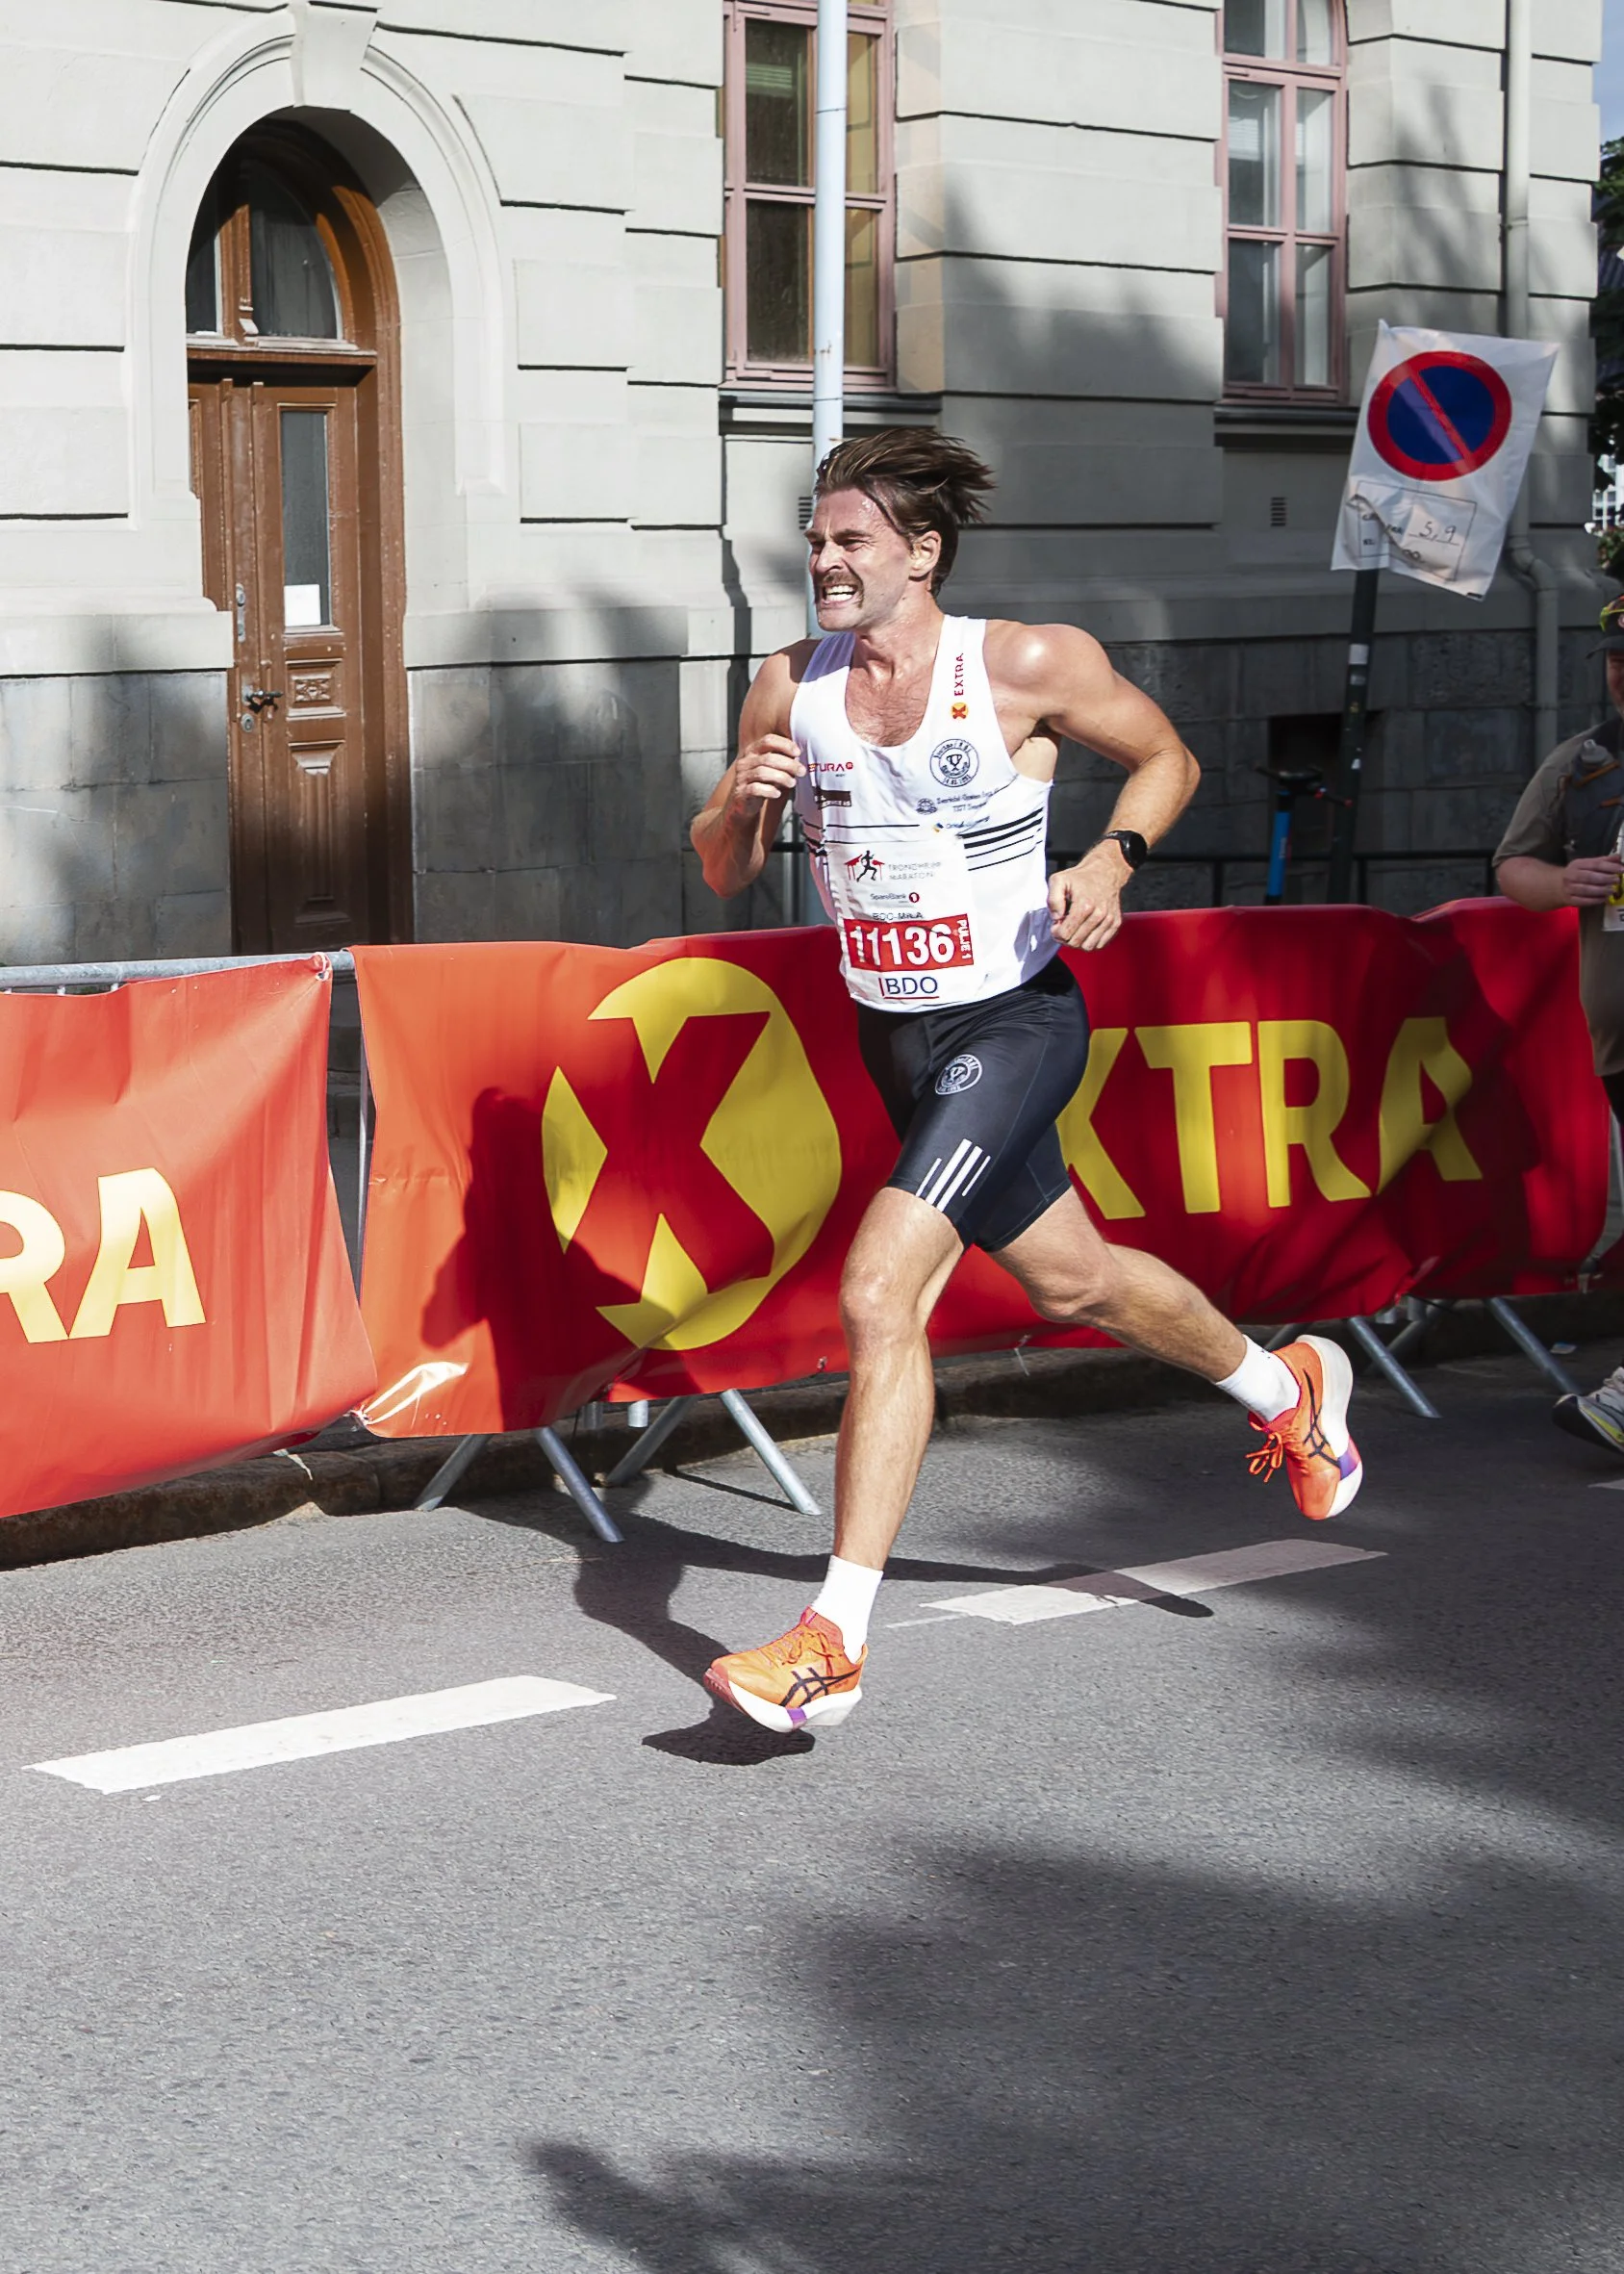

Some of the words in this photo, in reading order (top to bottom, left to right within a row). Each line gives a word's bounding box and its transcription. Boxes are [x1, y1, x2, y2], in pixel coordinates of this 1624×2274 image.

[953, 652, 964, 697] EXTRA
[850, 924, 955, 966] 11136
[885, 976, 938, 995] BDO
[0, 1167, 206, 1343] RA
